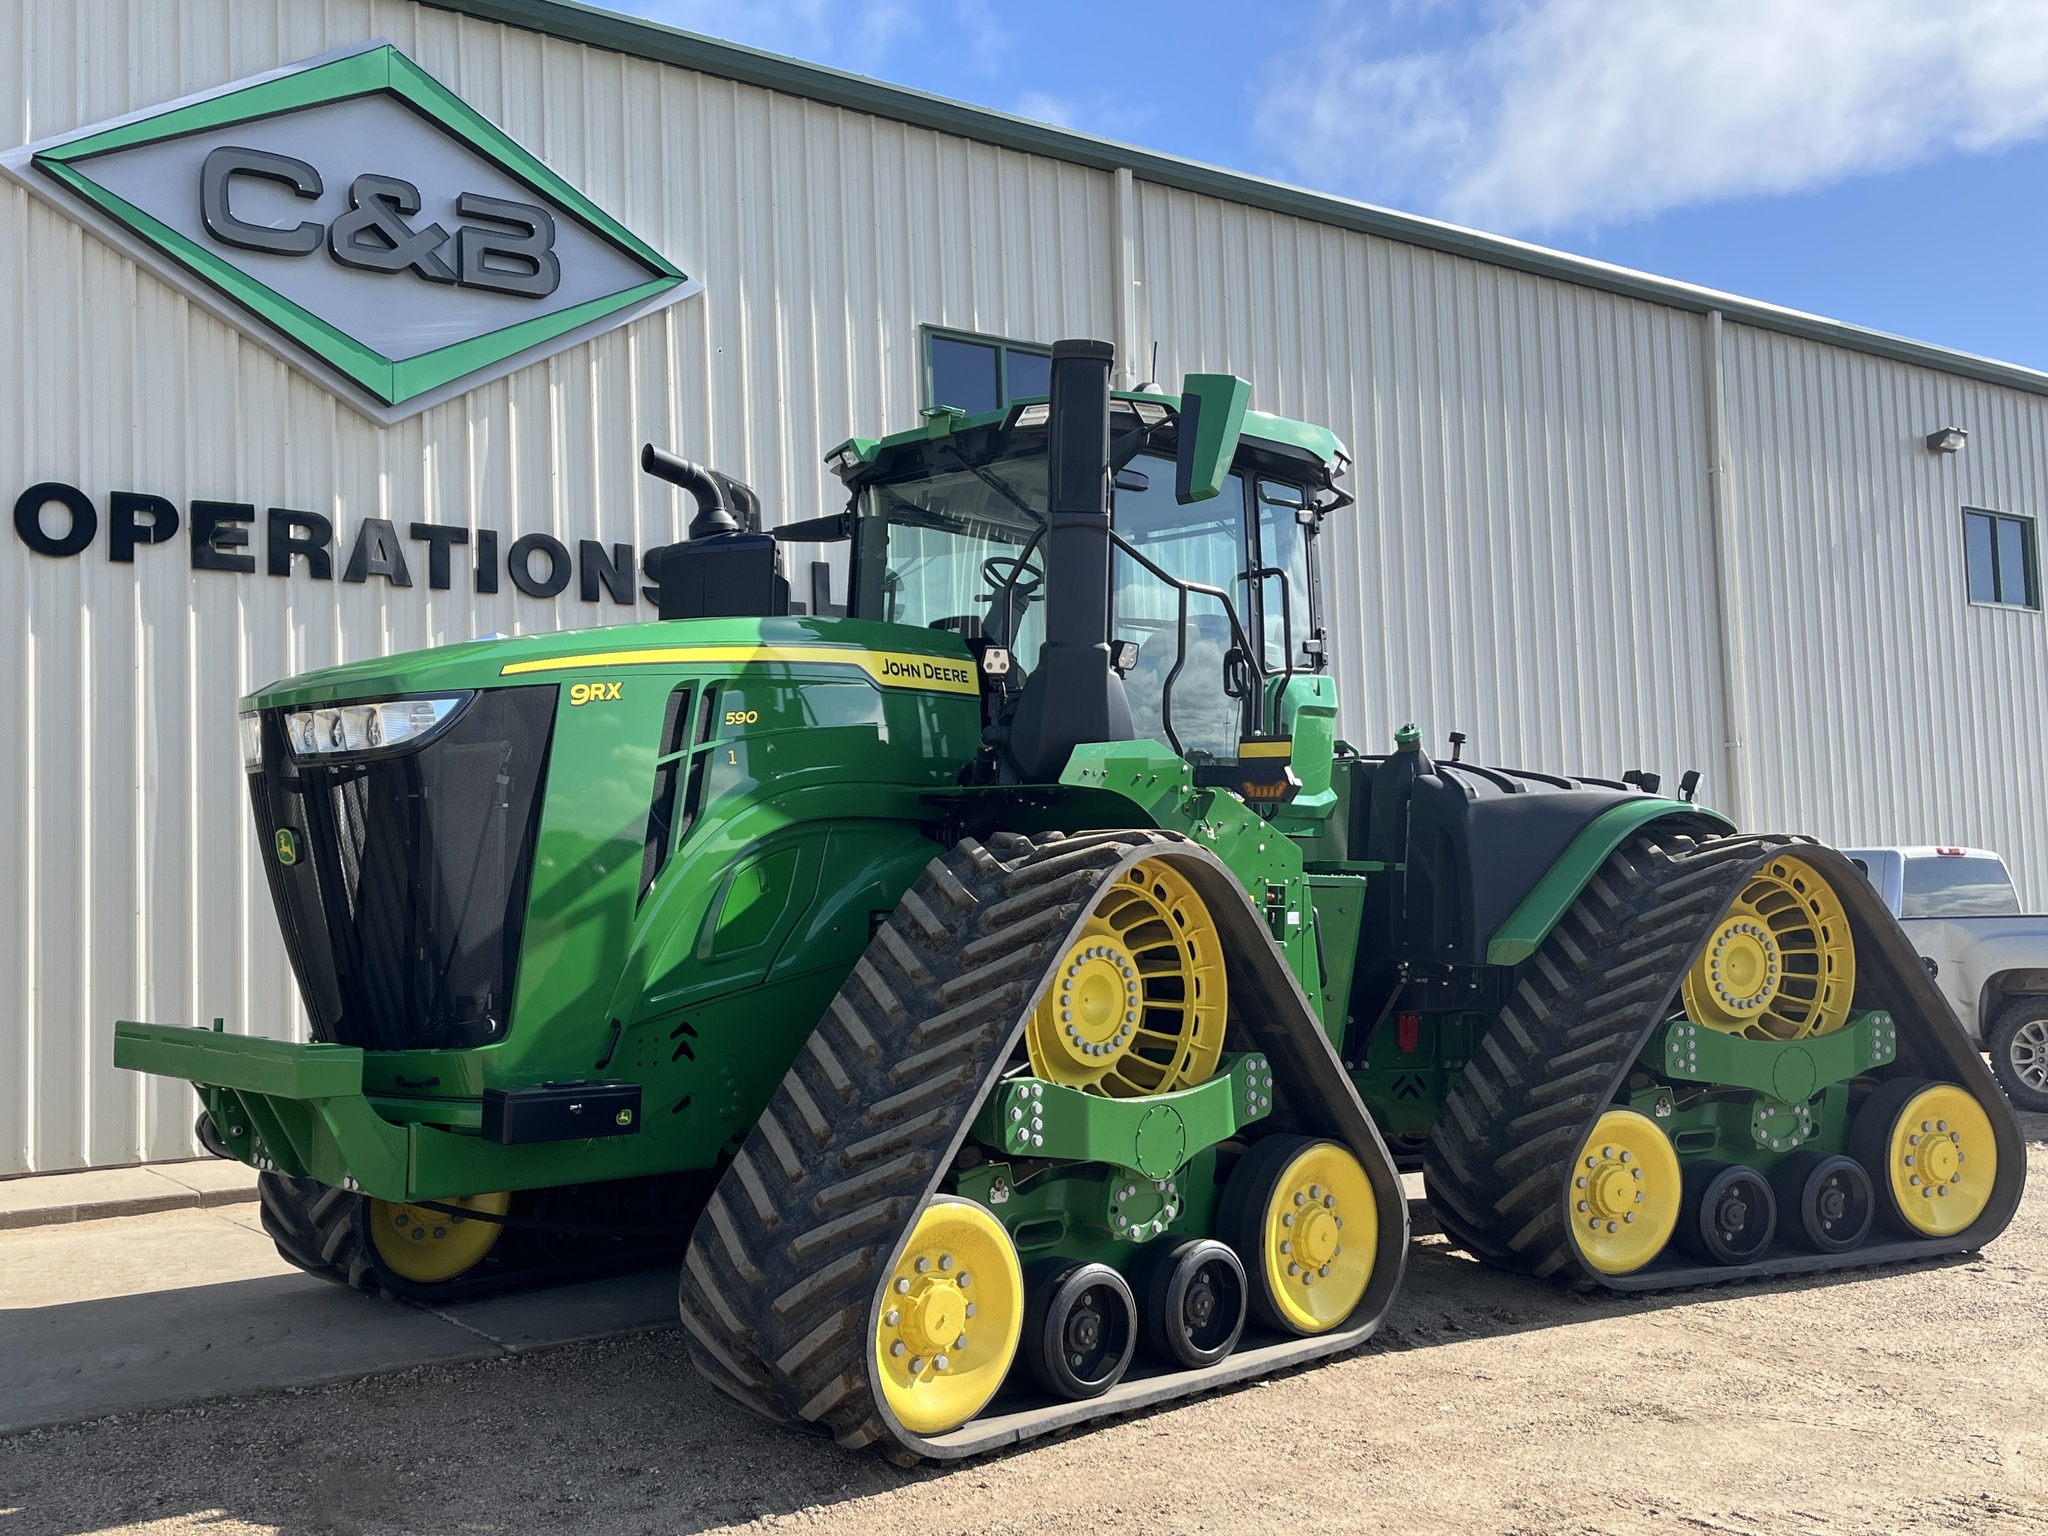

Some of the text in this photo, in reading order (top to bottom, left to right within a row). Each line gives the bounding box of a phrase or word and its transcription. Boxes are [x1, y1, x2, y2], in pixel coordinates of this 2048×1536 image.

[200, 145, 561, 299] C&B
[14, 482, 660, 606] OPERATION
[882, 658, 969, 683] JOHN DEERE
[570, 681, 624, 706] 9RX
[725, 710, 758, 726] 590
